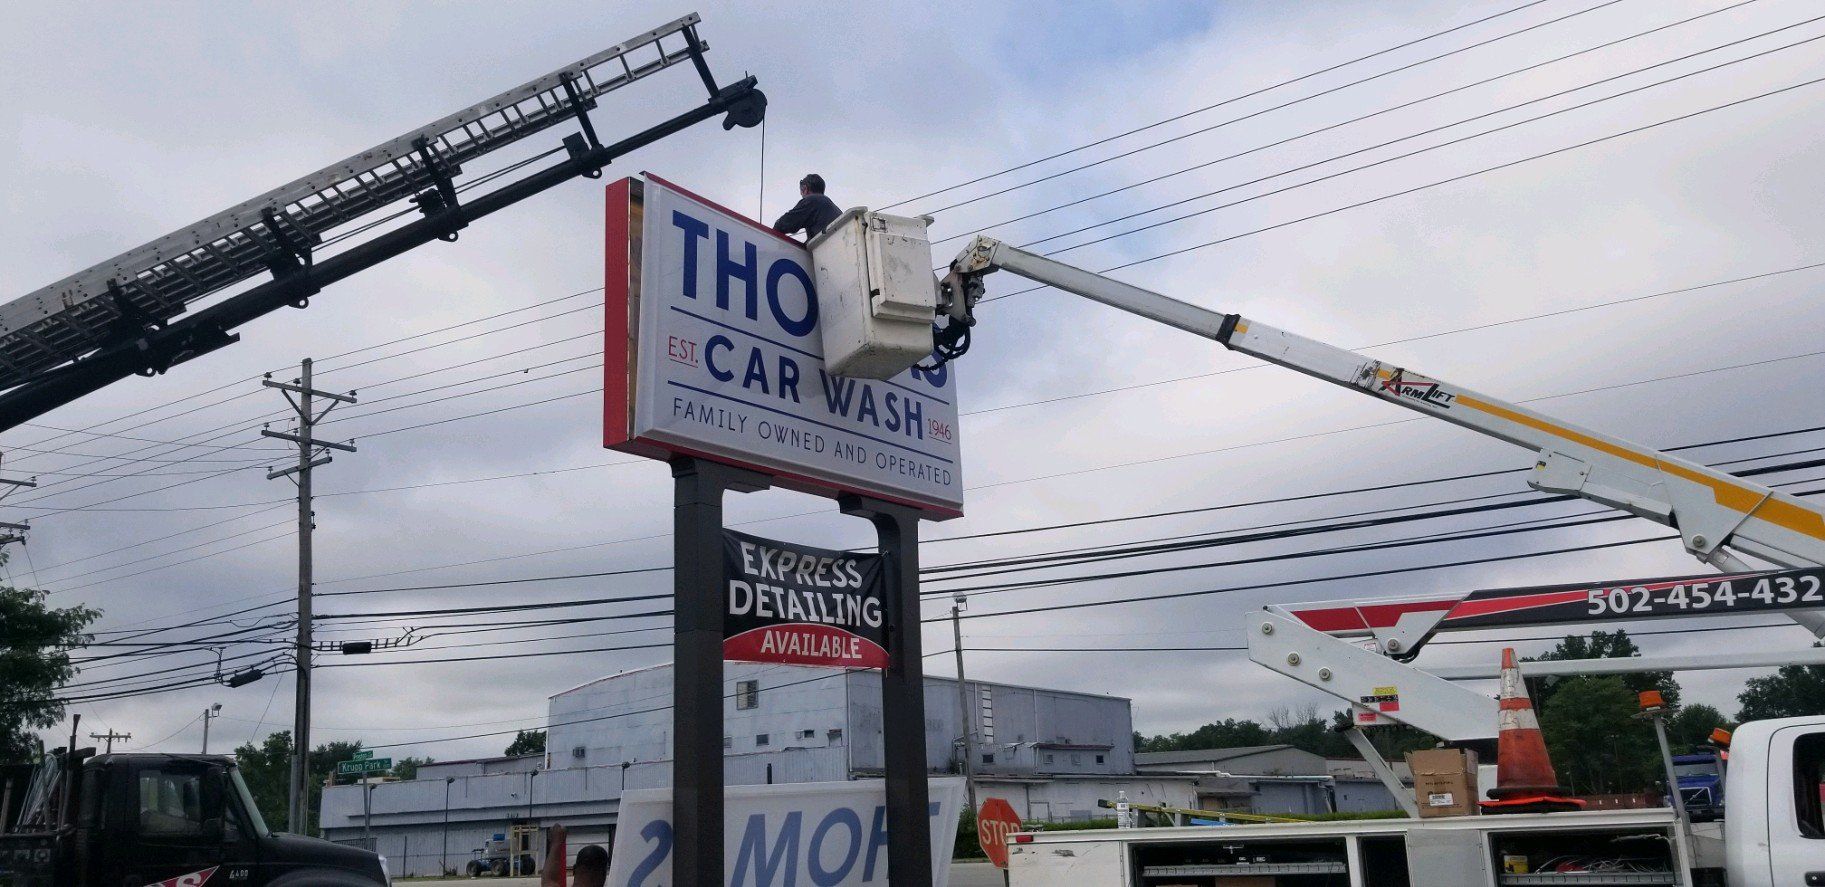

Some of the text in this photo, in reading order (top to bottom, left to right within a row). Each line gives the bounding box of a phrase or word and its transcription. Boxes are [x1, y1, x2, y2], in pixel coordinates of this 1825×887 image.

[669, 336, 698, 363] EST.
[704, 334, 923, 440] CAR WASH
[674, 398, 952, 486] FAMILY OWNED AND OPERATED
[928, 418, 952, 440] 1946
[740, 541, 863, 589] EXPRESS
[729, 579, 882, 627] DETAILING
[1588, 575, 1824, 614] 502-454-432
[760, 630, 863, 659] AVAILABLE
[365, 760, 381, 770] Park
